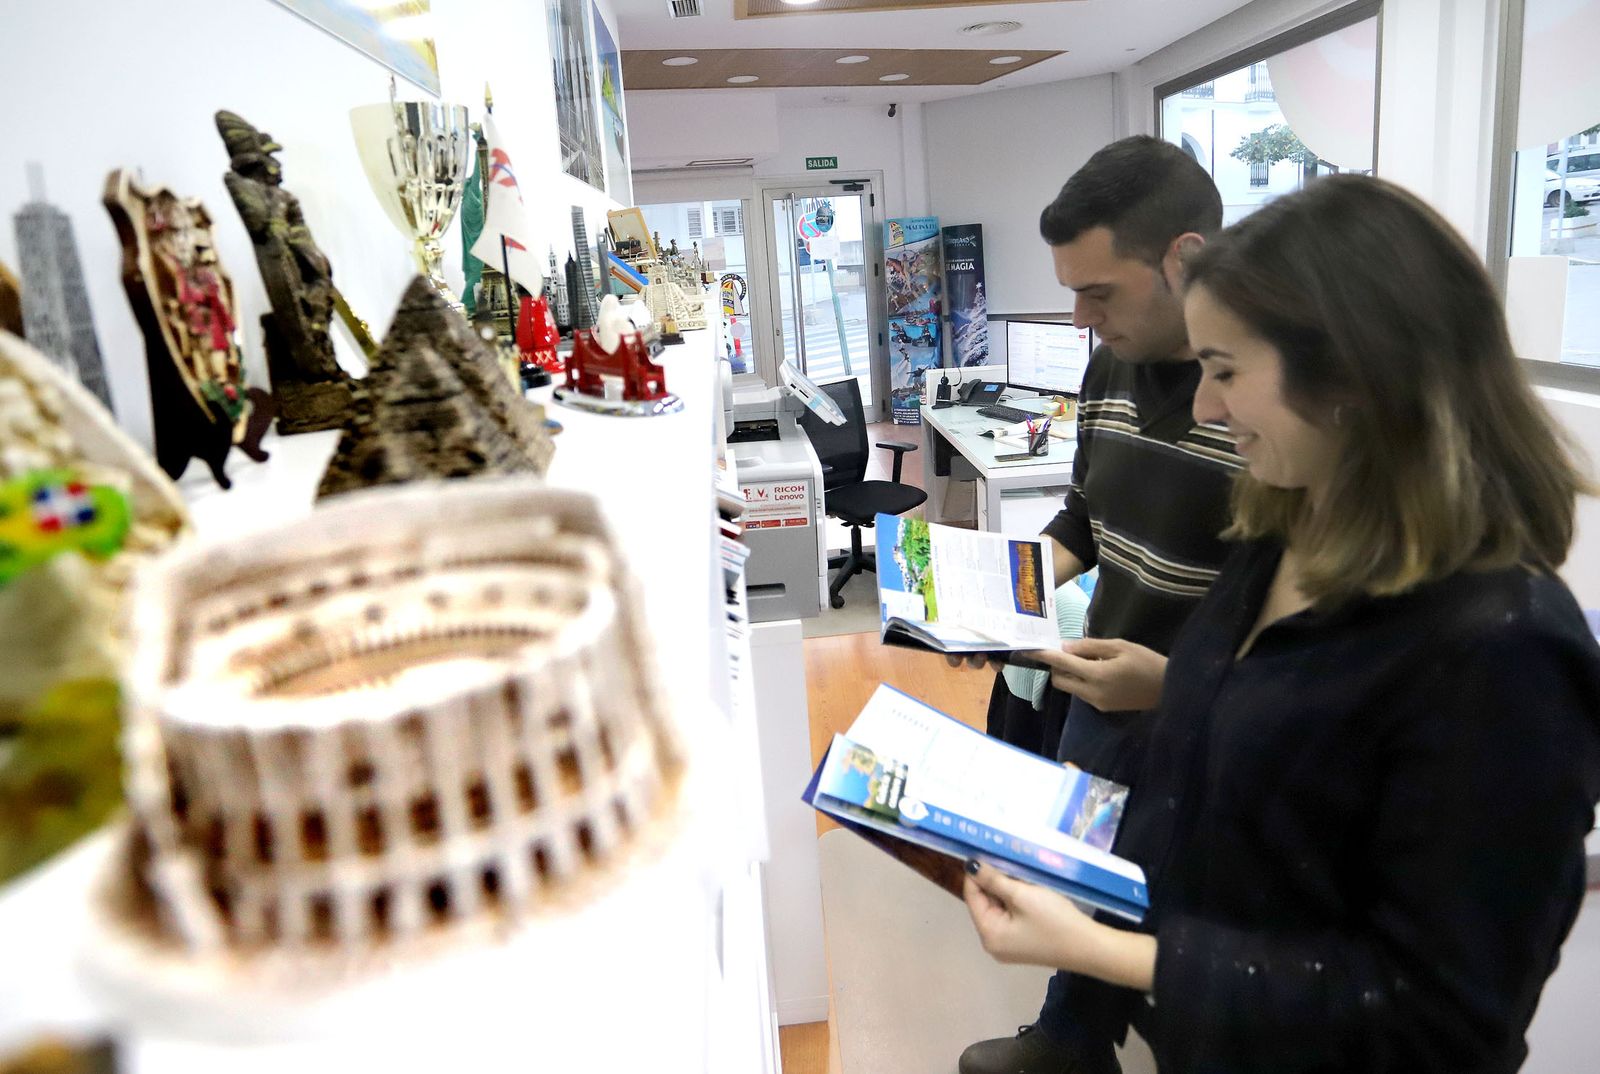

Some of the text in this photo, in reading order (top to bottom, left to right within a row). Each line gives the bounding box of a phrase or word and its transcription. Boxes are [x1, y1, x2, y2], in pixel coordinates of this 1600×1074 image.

[807, 158, 835, 168] SALIDA
[774, 485, 805, 493] RICOH
[774, 493, 805, 501] Lenovo
